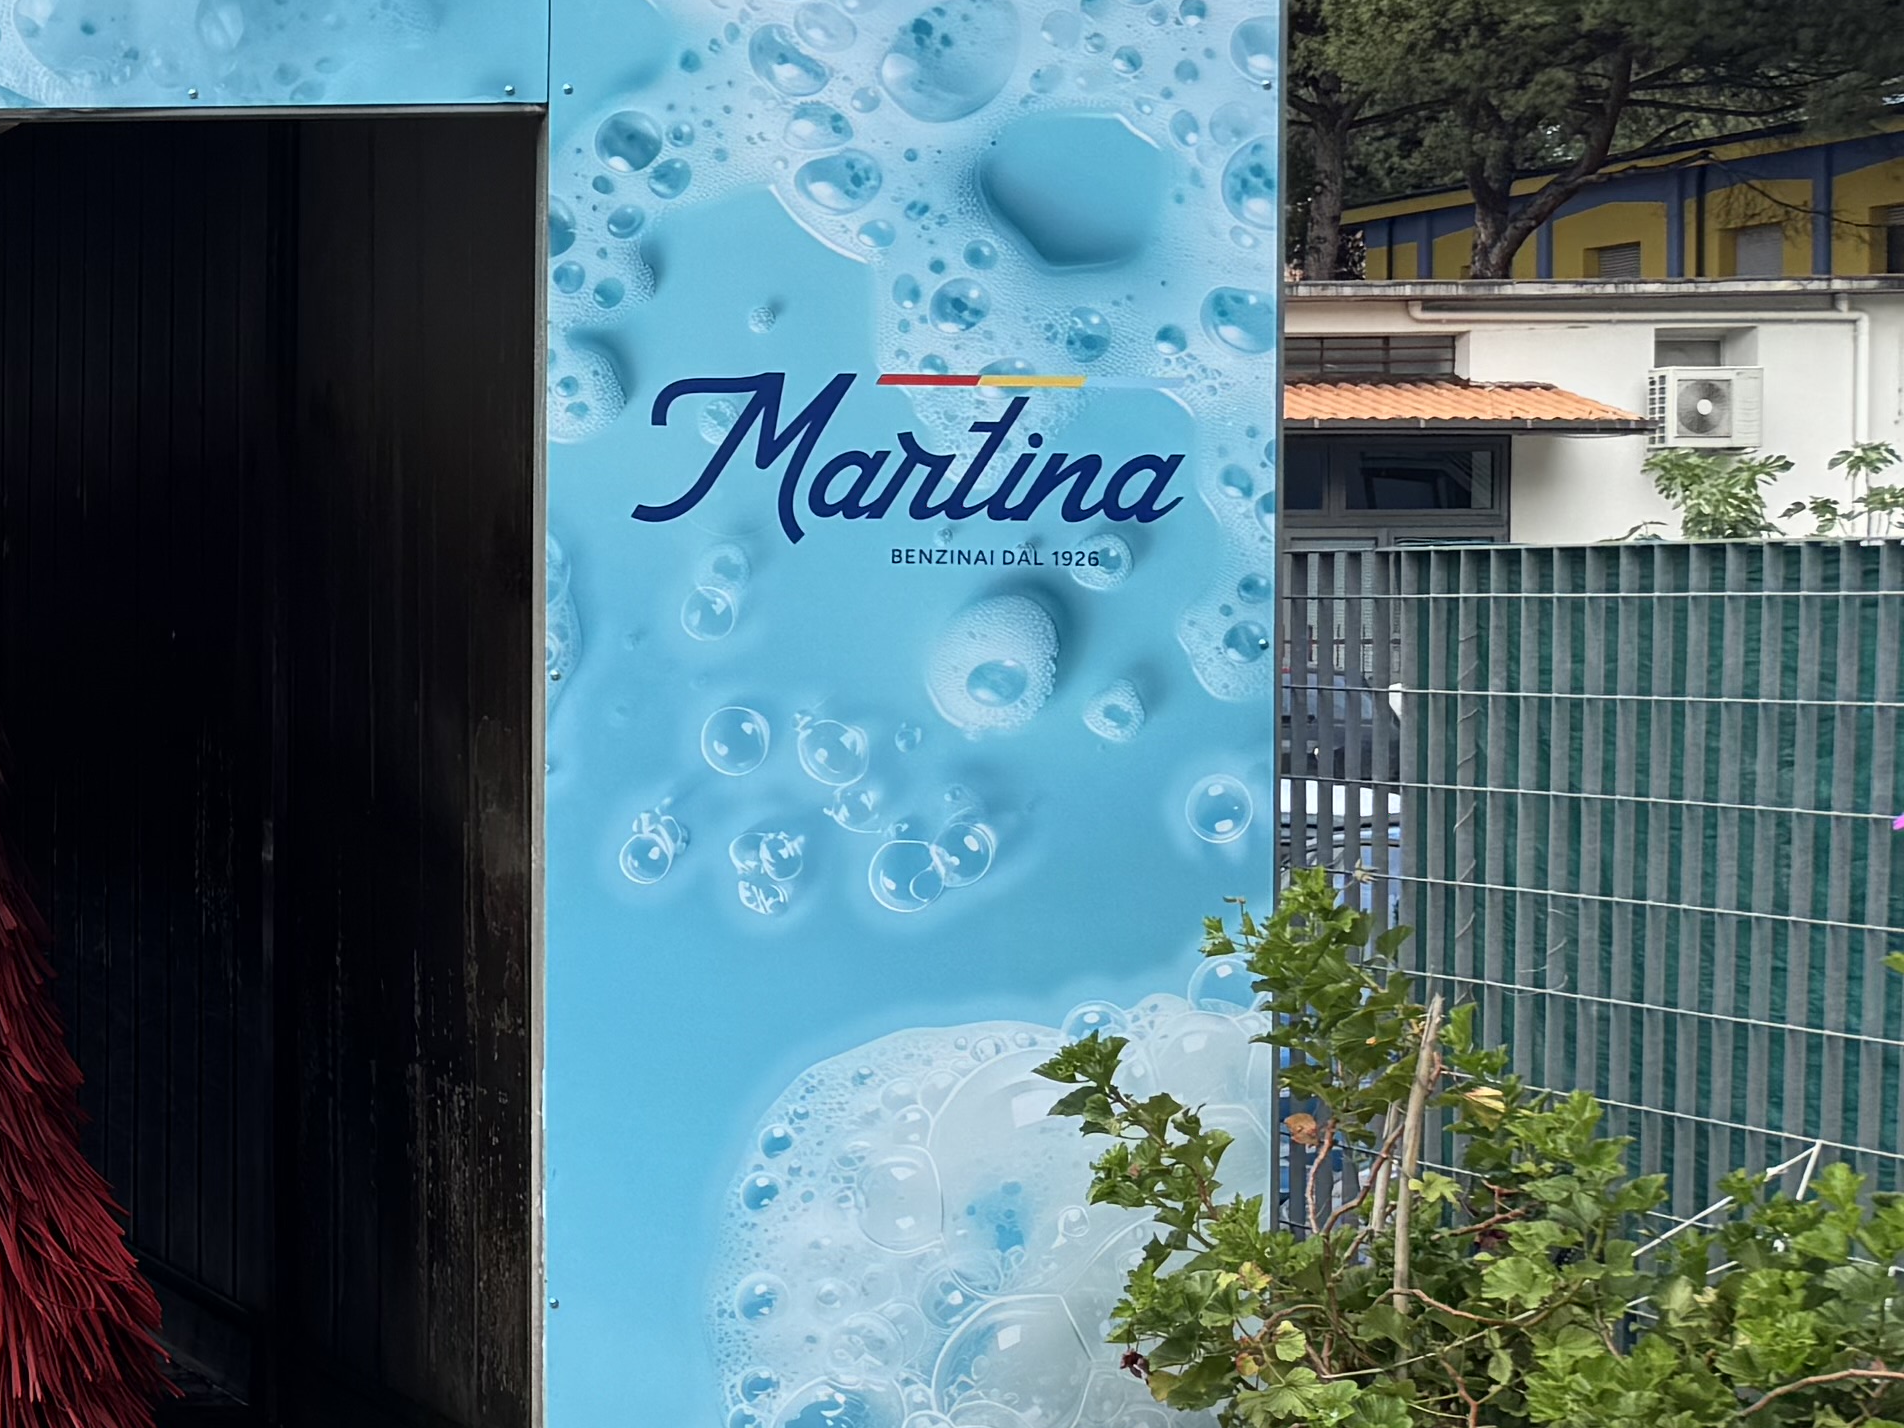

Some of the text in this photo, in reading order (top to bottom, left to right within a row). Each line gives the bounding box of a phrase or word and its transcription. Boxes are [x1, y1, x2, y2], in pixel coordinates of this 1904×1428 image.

[631, 372, 1186, 544] Martina
[892, 548, 1099, 567] BENZINAI DAL 1926
